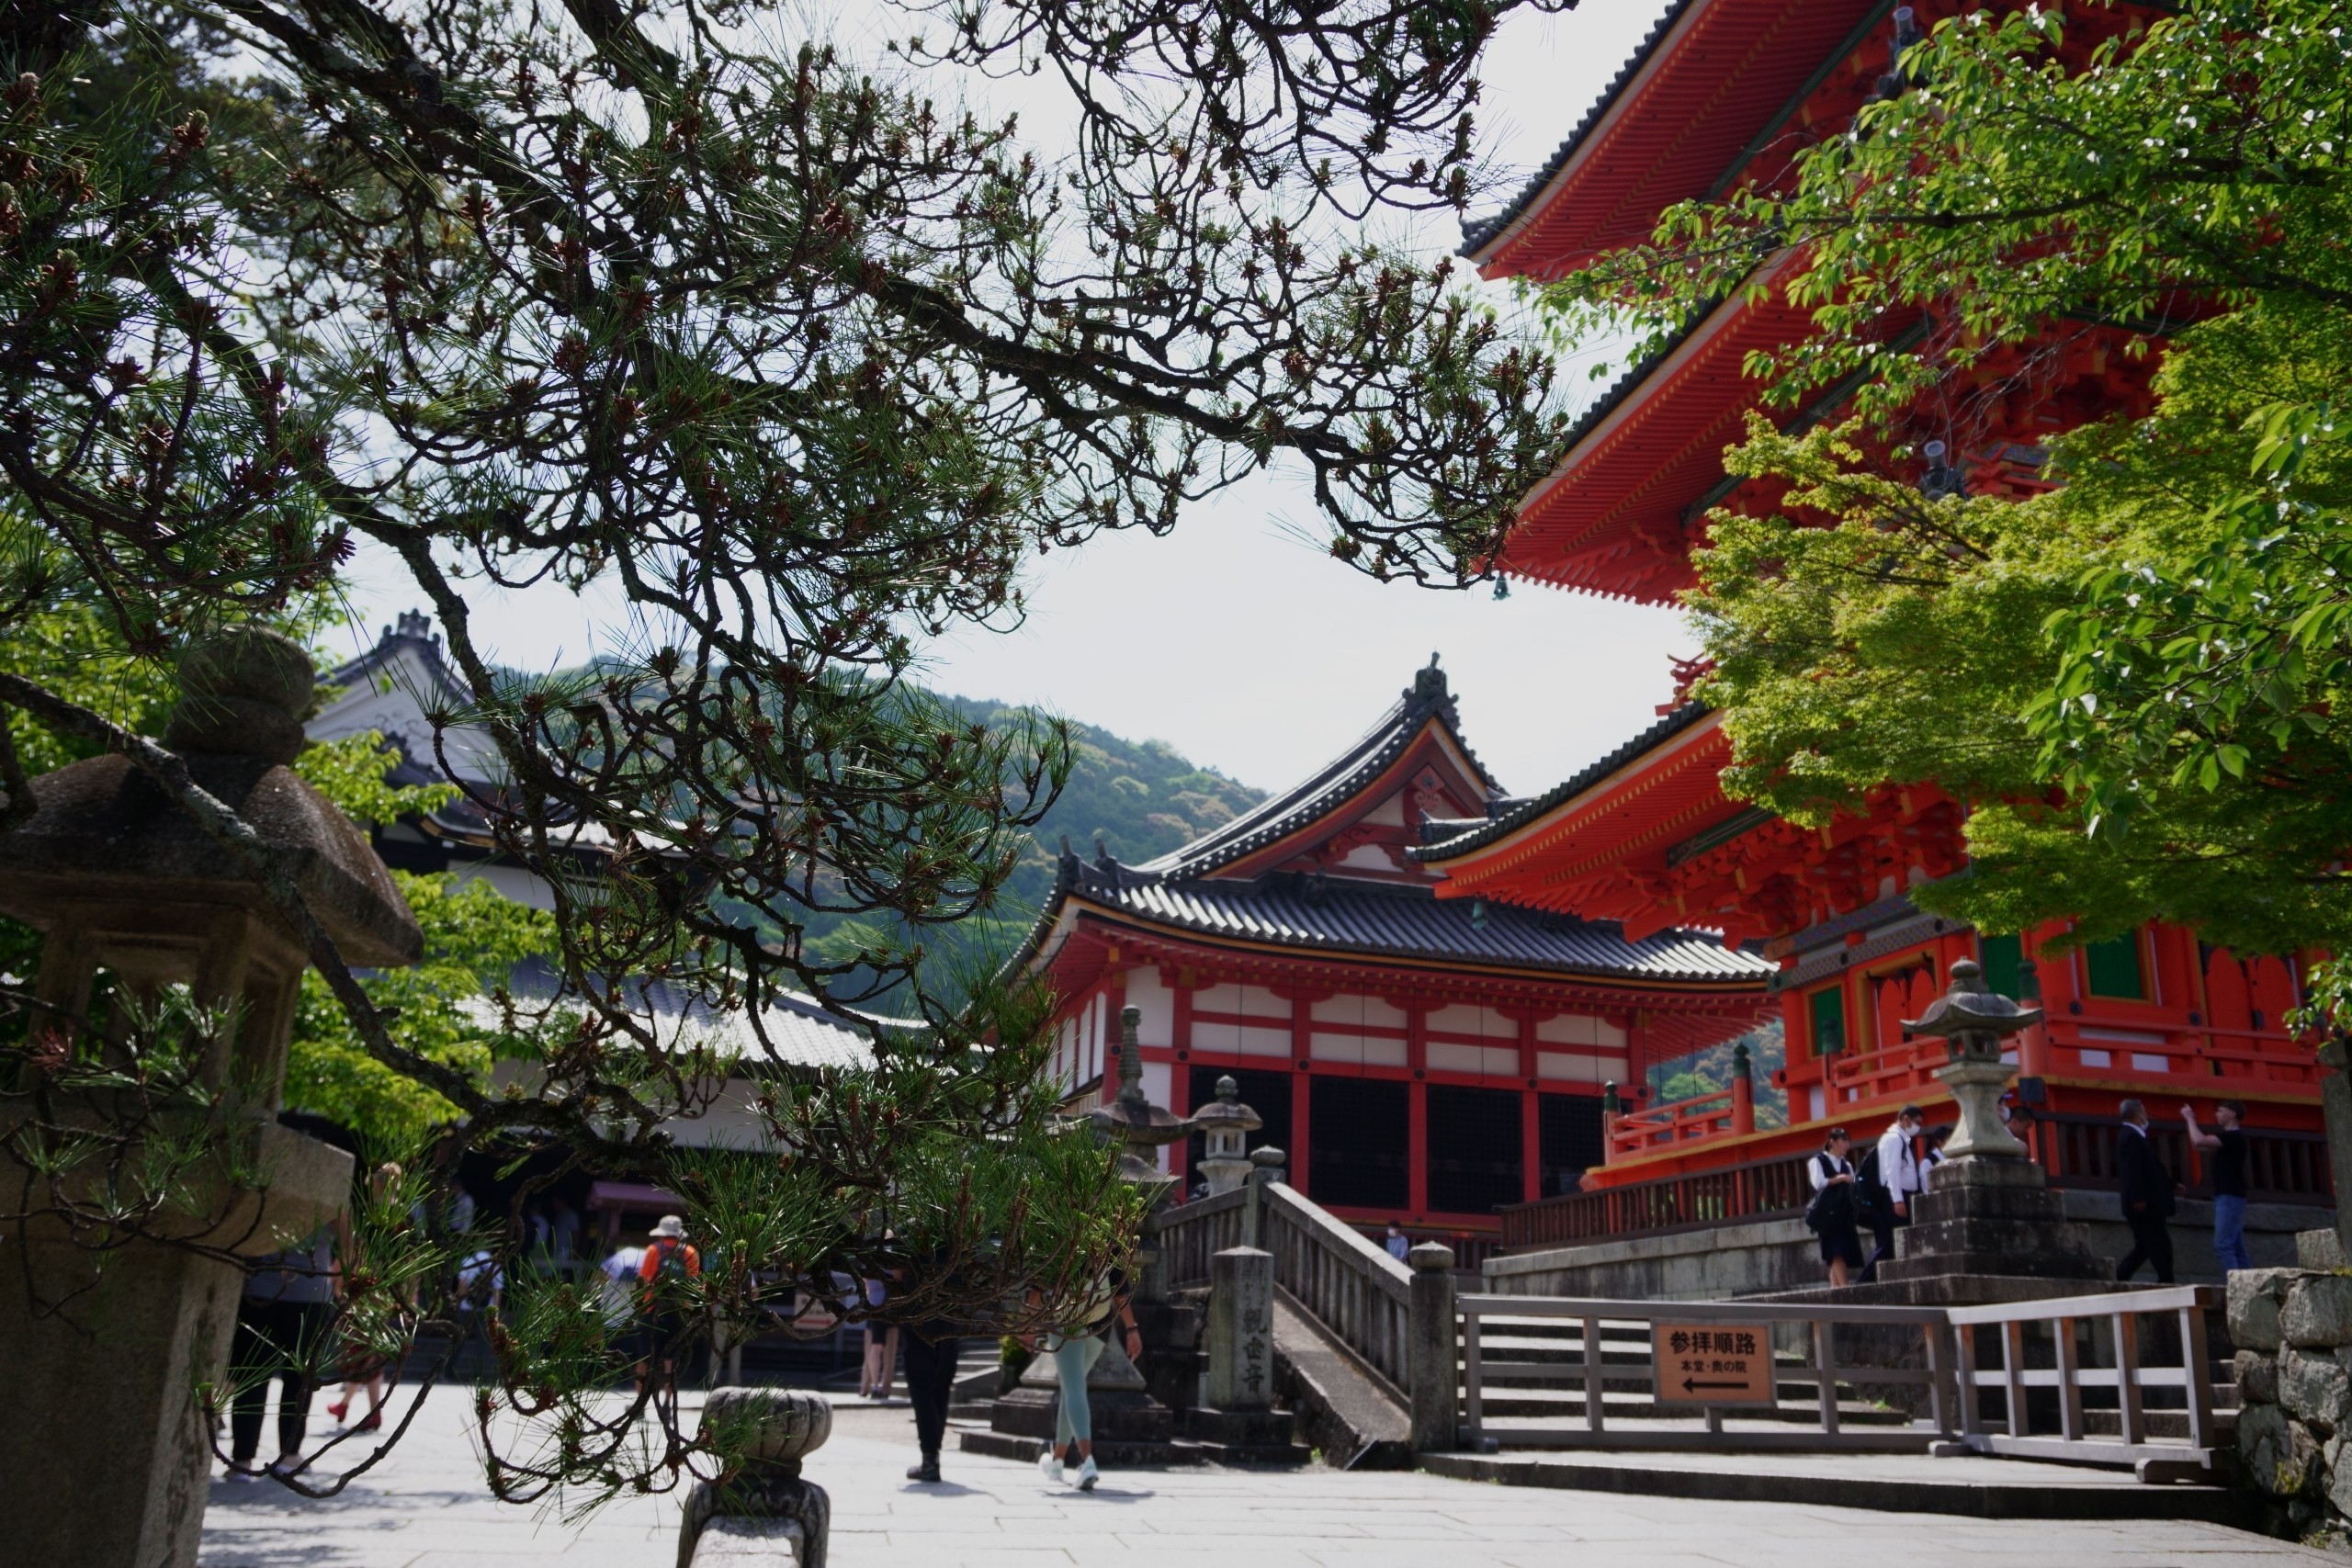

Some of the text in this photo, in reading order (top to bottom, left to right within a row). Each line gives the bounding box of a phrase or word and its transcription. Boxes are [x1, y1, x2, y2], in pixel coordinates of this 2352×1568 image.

[1669, 1331, 1756, 1355] 参拝順路
[1680, 1359, 1747, 1373] 本堂・奥の院
